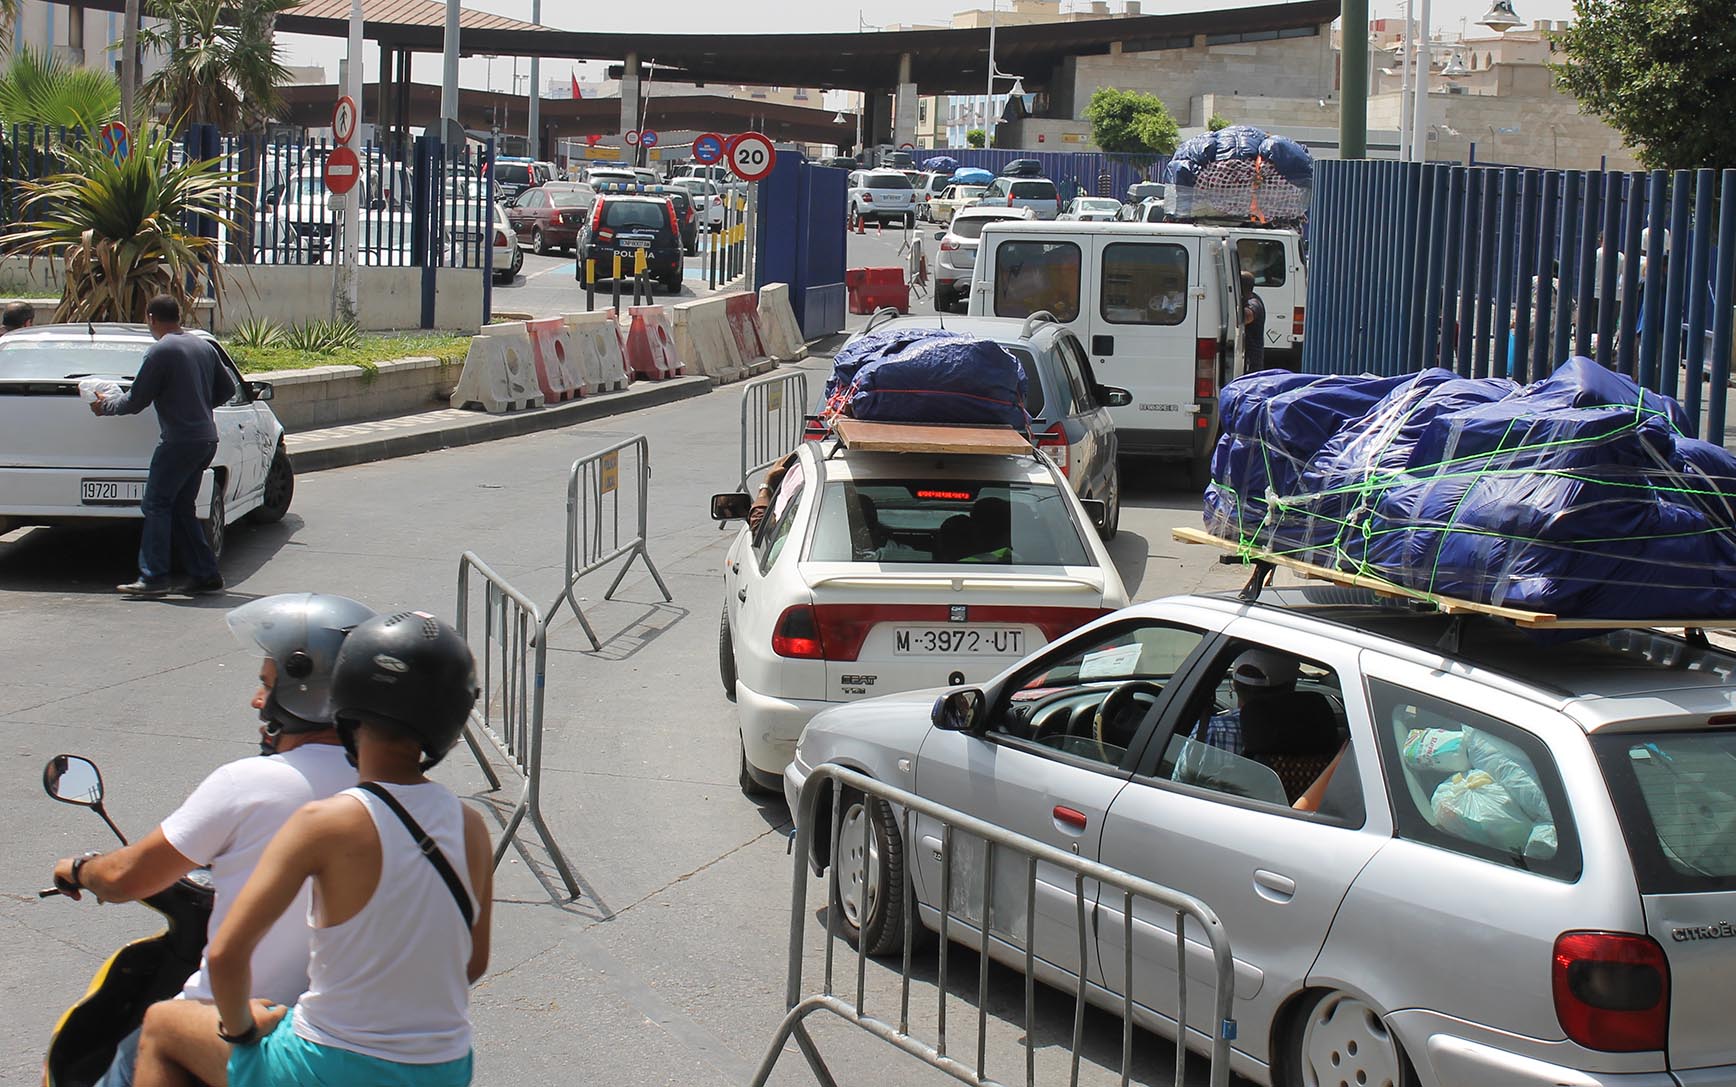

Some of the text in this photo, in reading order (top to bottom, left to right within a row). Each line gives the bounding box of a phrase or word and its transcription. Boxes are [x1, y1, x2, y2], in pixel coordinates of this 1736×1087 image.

[738, 149, 764, 164] 20
[613, 250, 655, 259] POLIA
[83, 483, 118, 498] 19720
[841, 674, 878, 685] SEAT
